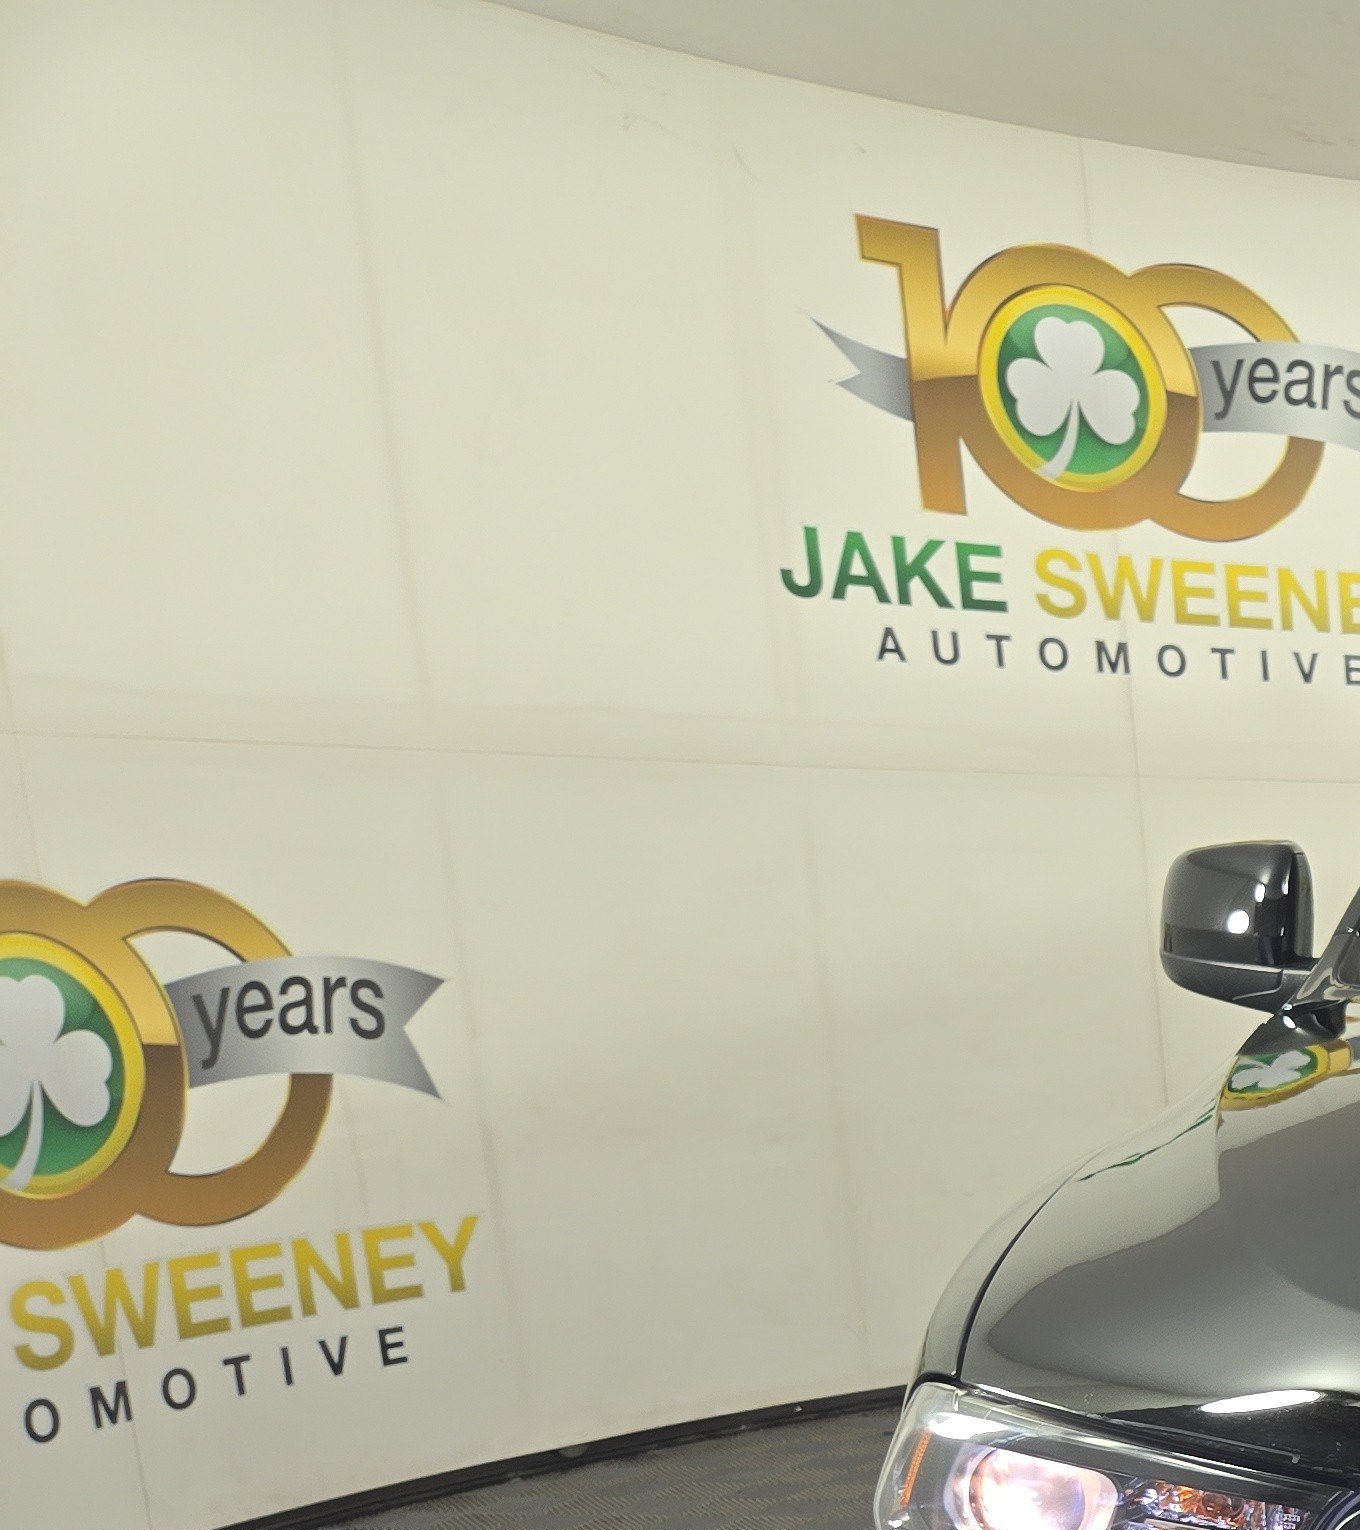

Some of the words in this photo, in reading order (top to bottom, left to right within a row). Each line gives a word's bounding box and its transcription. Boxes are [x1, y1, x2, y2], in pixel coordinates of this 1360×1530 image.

[854, 213, 1325, 542] 100
[779, 525, 1009, 614] JAKE
[192, 975, 387, 1070] years
[10, 1214, 480, 1371] SWEENEY
